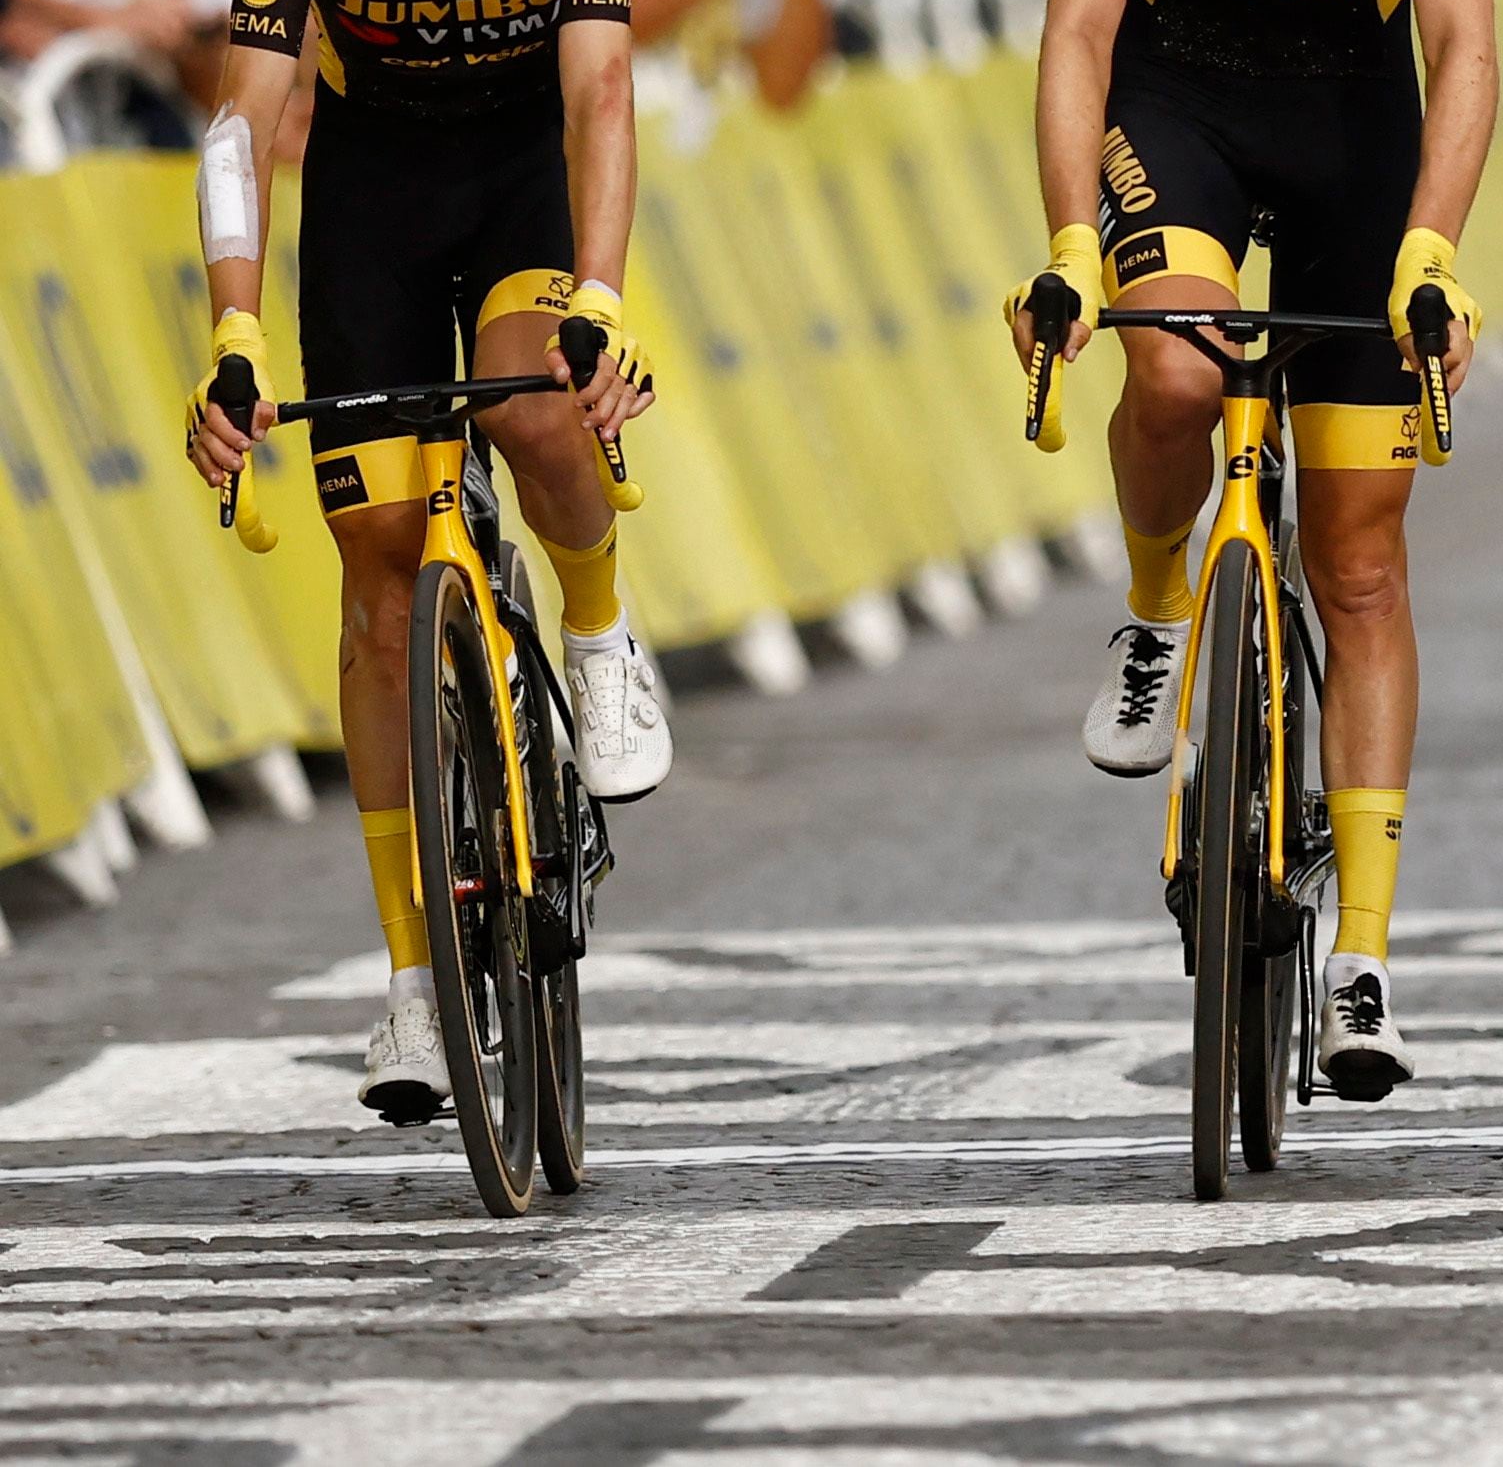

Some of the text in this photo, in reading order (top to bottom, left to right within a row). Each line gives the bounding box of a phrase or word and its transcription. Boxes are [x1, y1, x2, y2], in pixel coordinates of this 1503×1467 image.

[1118, 246, 1161, 273] HEMA
[534, 296, 570, 311] AG
[1027, 341, 1047, 420] SRAM
[1425, 355, 1450, 432] SRAM
